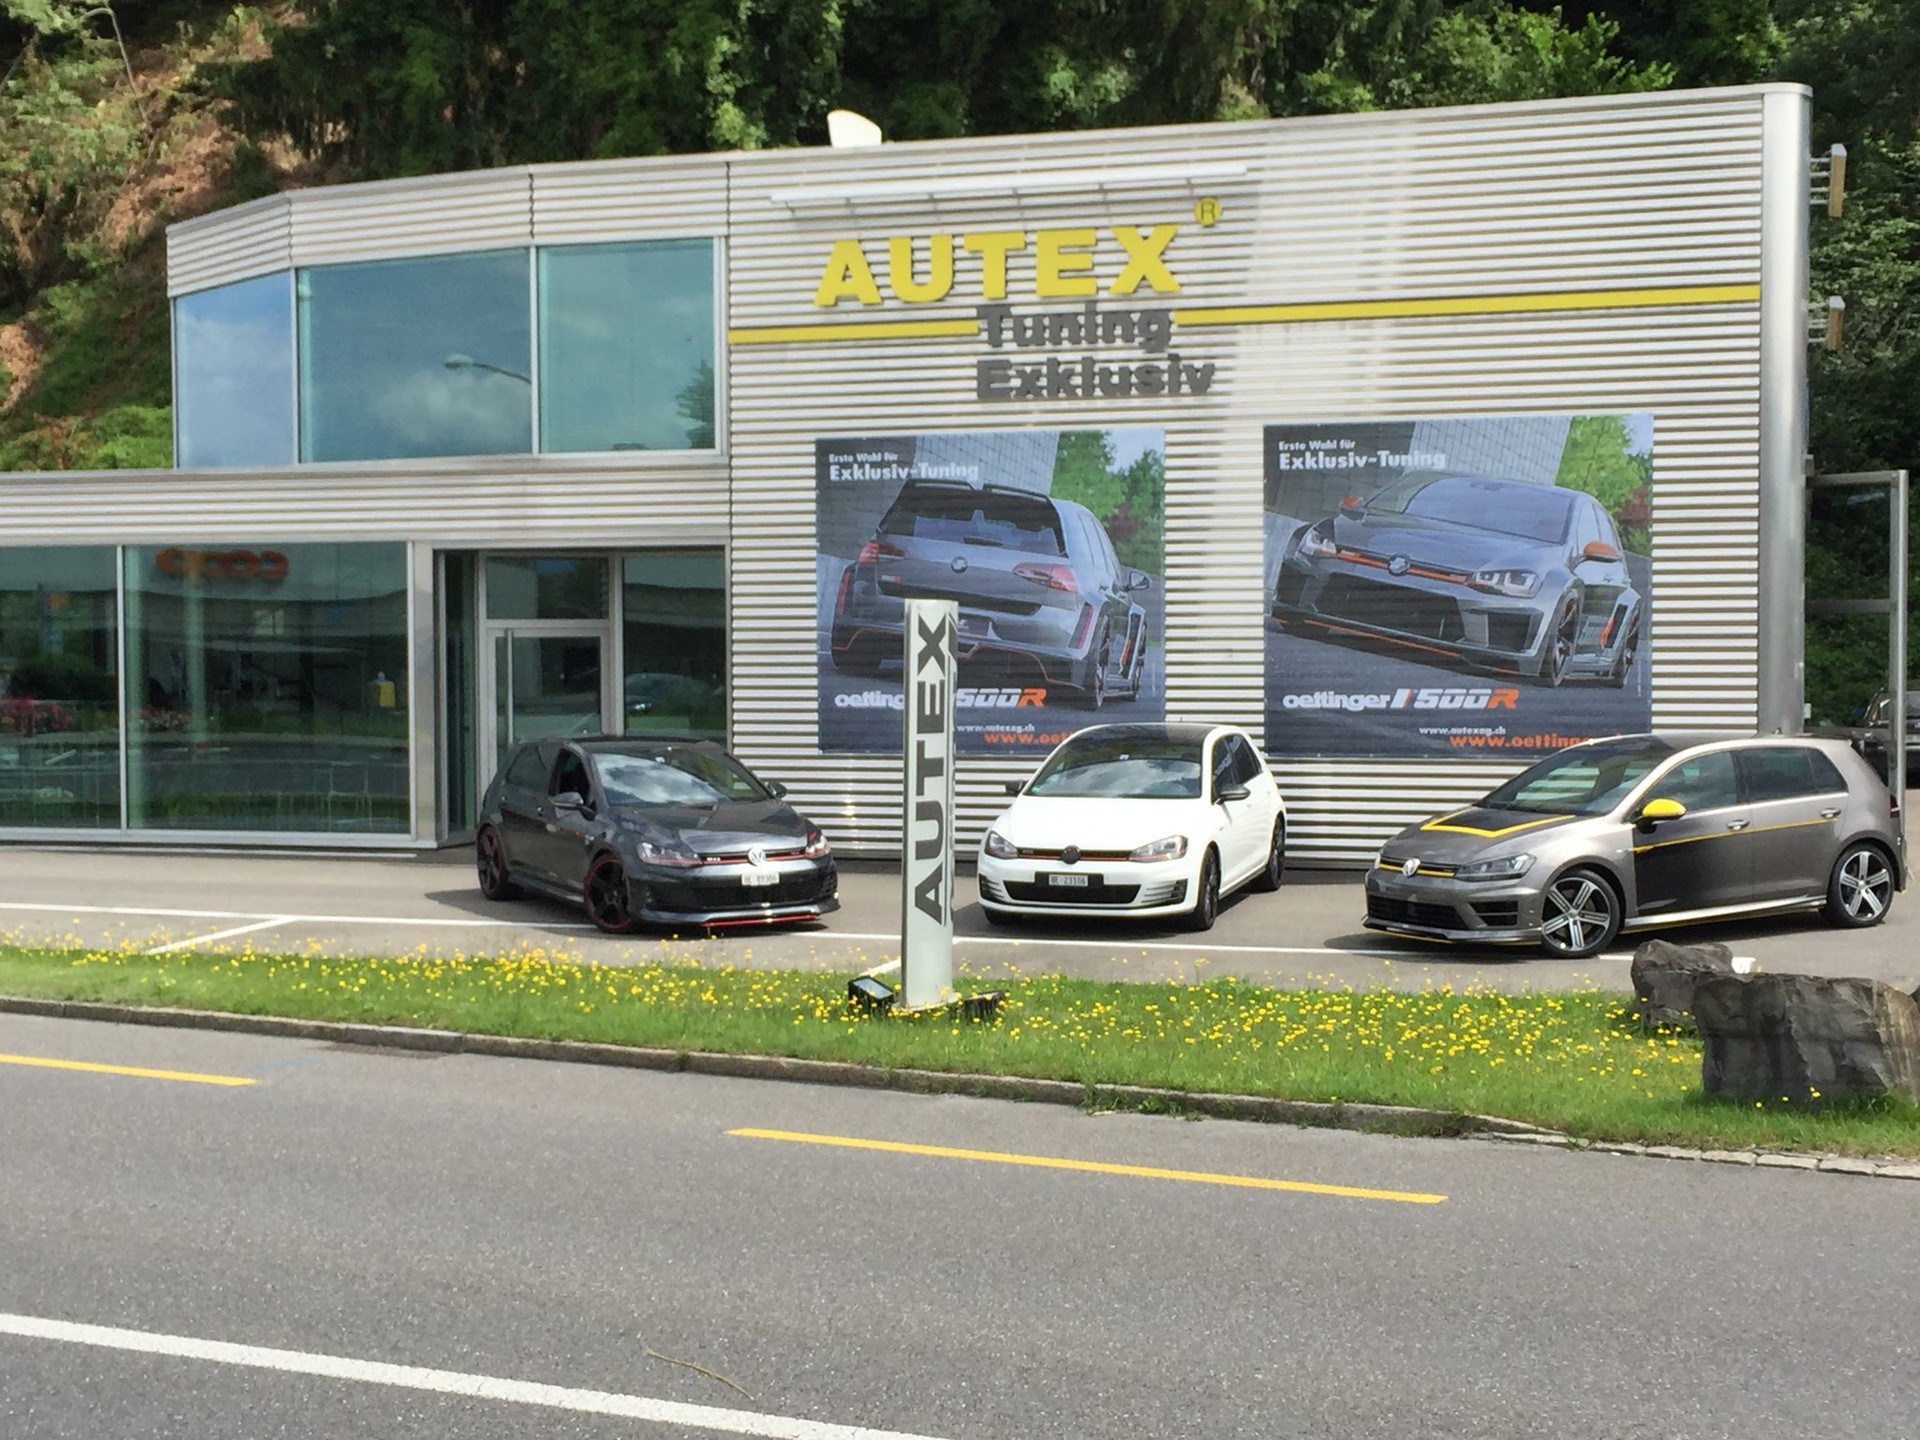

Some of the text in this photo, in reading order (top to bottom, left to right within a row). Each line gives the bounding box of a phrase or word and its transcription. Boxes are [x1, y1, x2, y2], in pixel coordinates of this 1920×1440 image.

[813, 224, 1182, 307] AUTEX
[976, 300, 1172, 354] Tuning
[976, 353, 1216, 400] Exklusiv
[1278, 439, 1356, 451] Erste Wahl für
[828, 453, 854, 464] Erste
[856, 452, 882, 463] Wahl
[1278, 450, 1447, 471] Exklusiv-Tuning
[828, 462, 980, 482] Exklusiv-Tuning
[834, 688, 1047, 710] oetting 500R
[1282, 690, 1391, 712] oettinger
[984, 731, 1071, 745] www.oet
[914, 613, 946, 926] AUTEX
